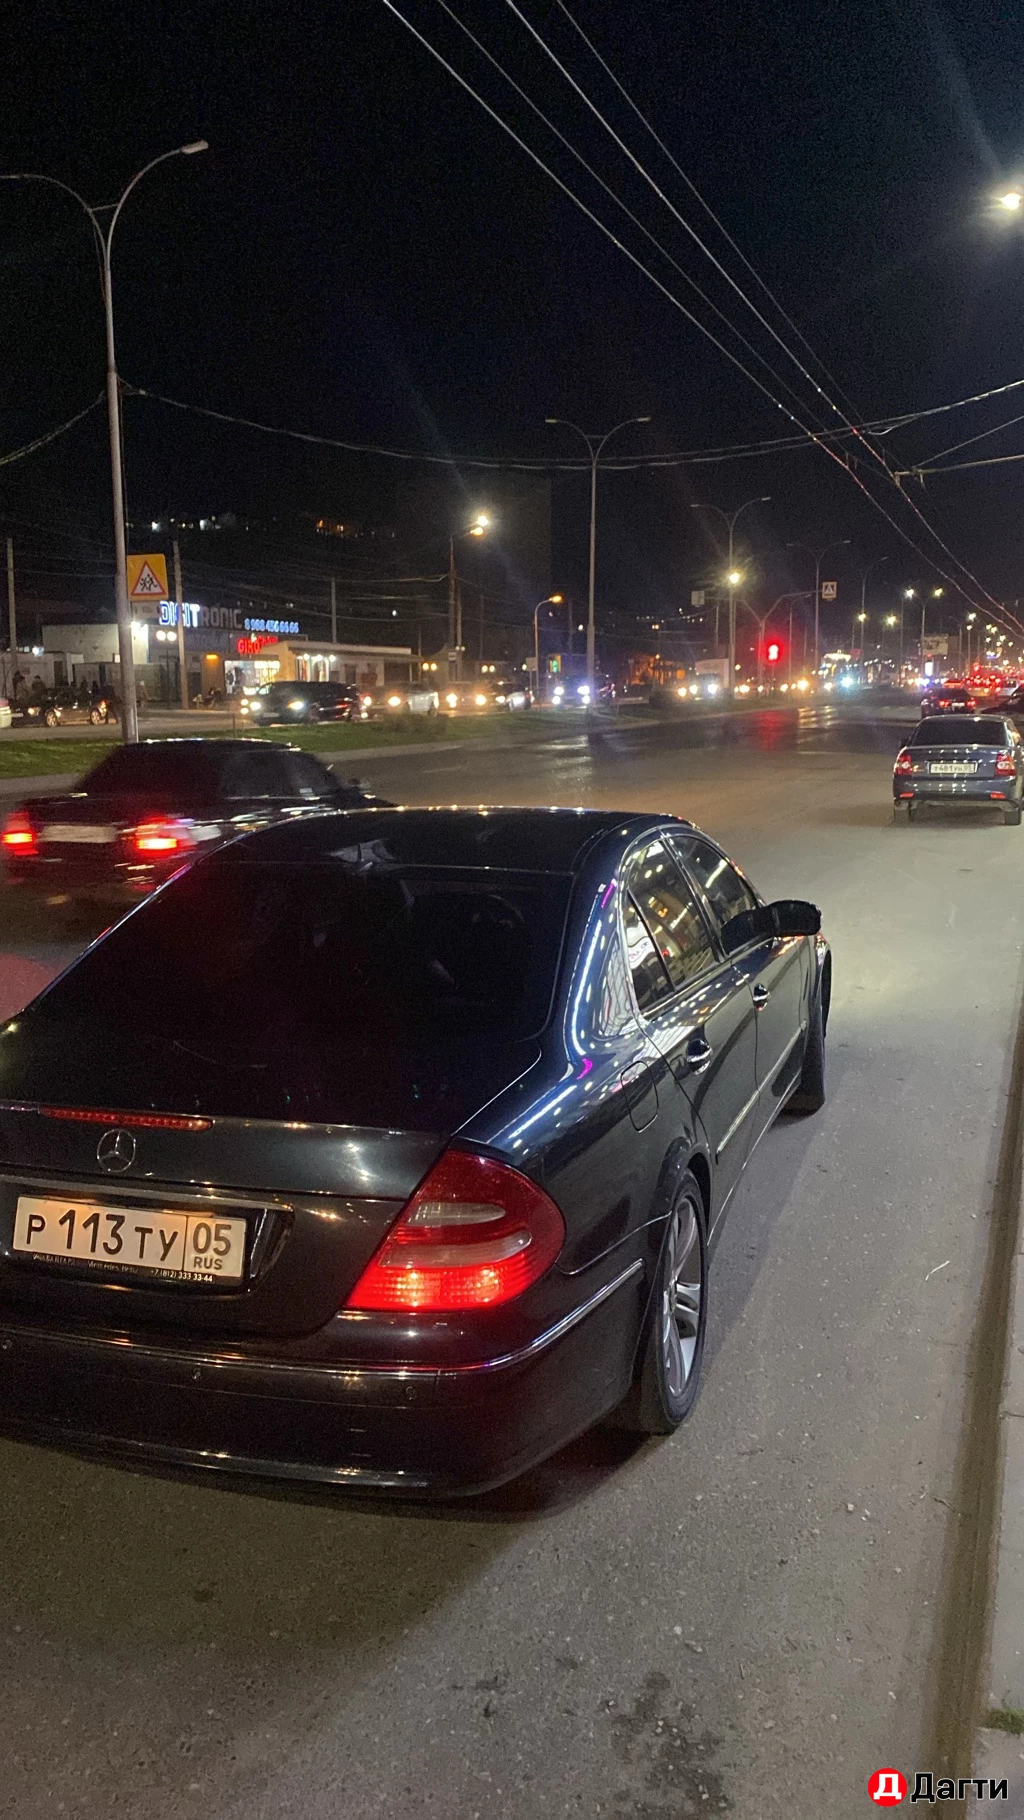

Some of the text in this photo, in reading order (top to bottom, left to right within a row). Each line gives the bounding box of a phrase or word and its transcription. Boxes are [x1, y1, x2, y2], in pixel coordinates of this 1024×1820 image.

[192, 1221, 232, 1256] 05
[193, 1257, 222, 1270] RUS
[178, 1271, 192, 1280] 333
[193, 1273, 213, 1282] 33-44
